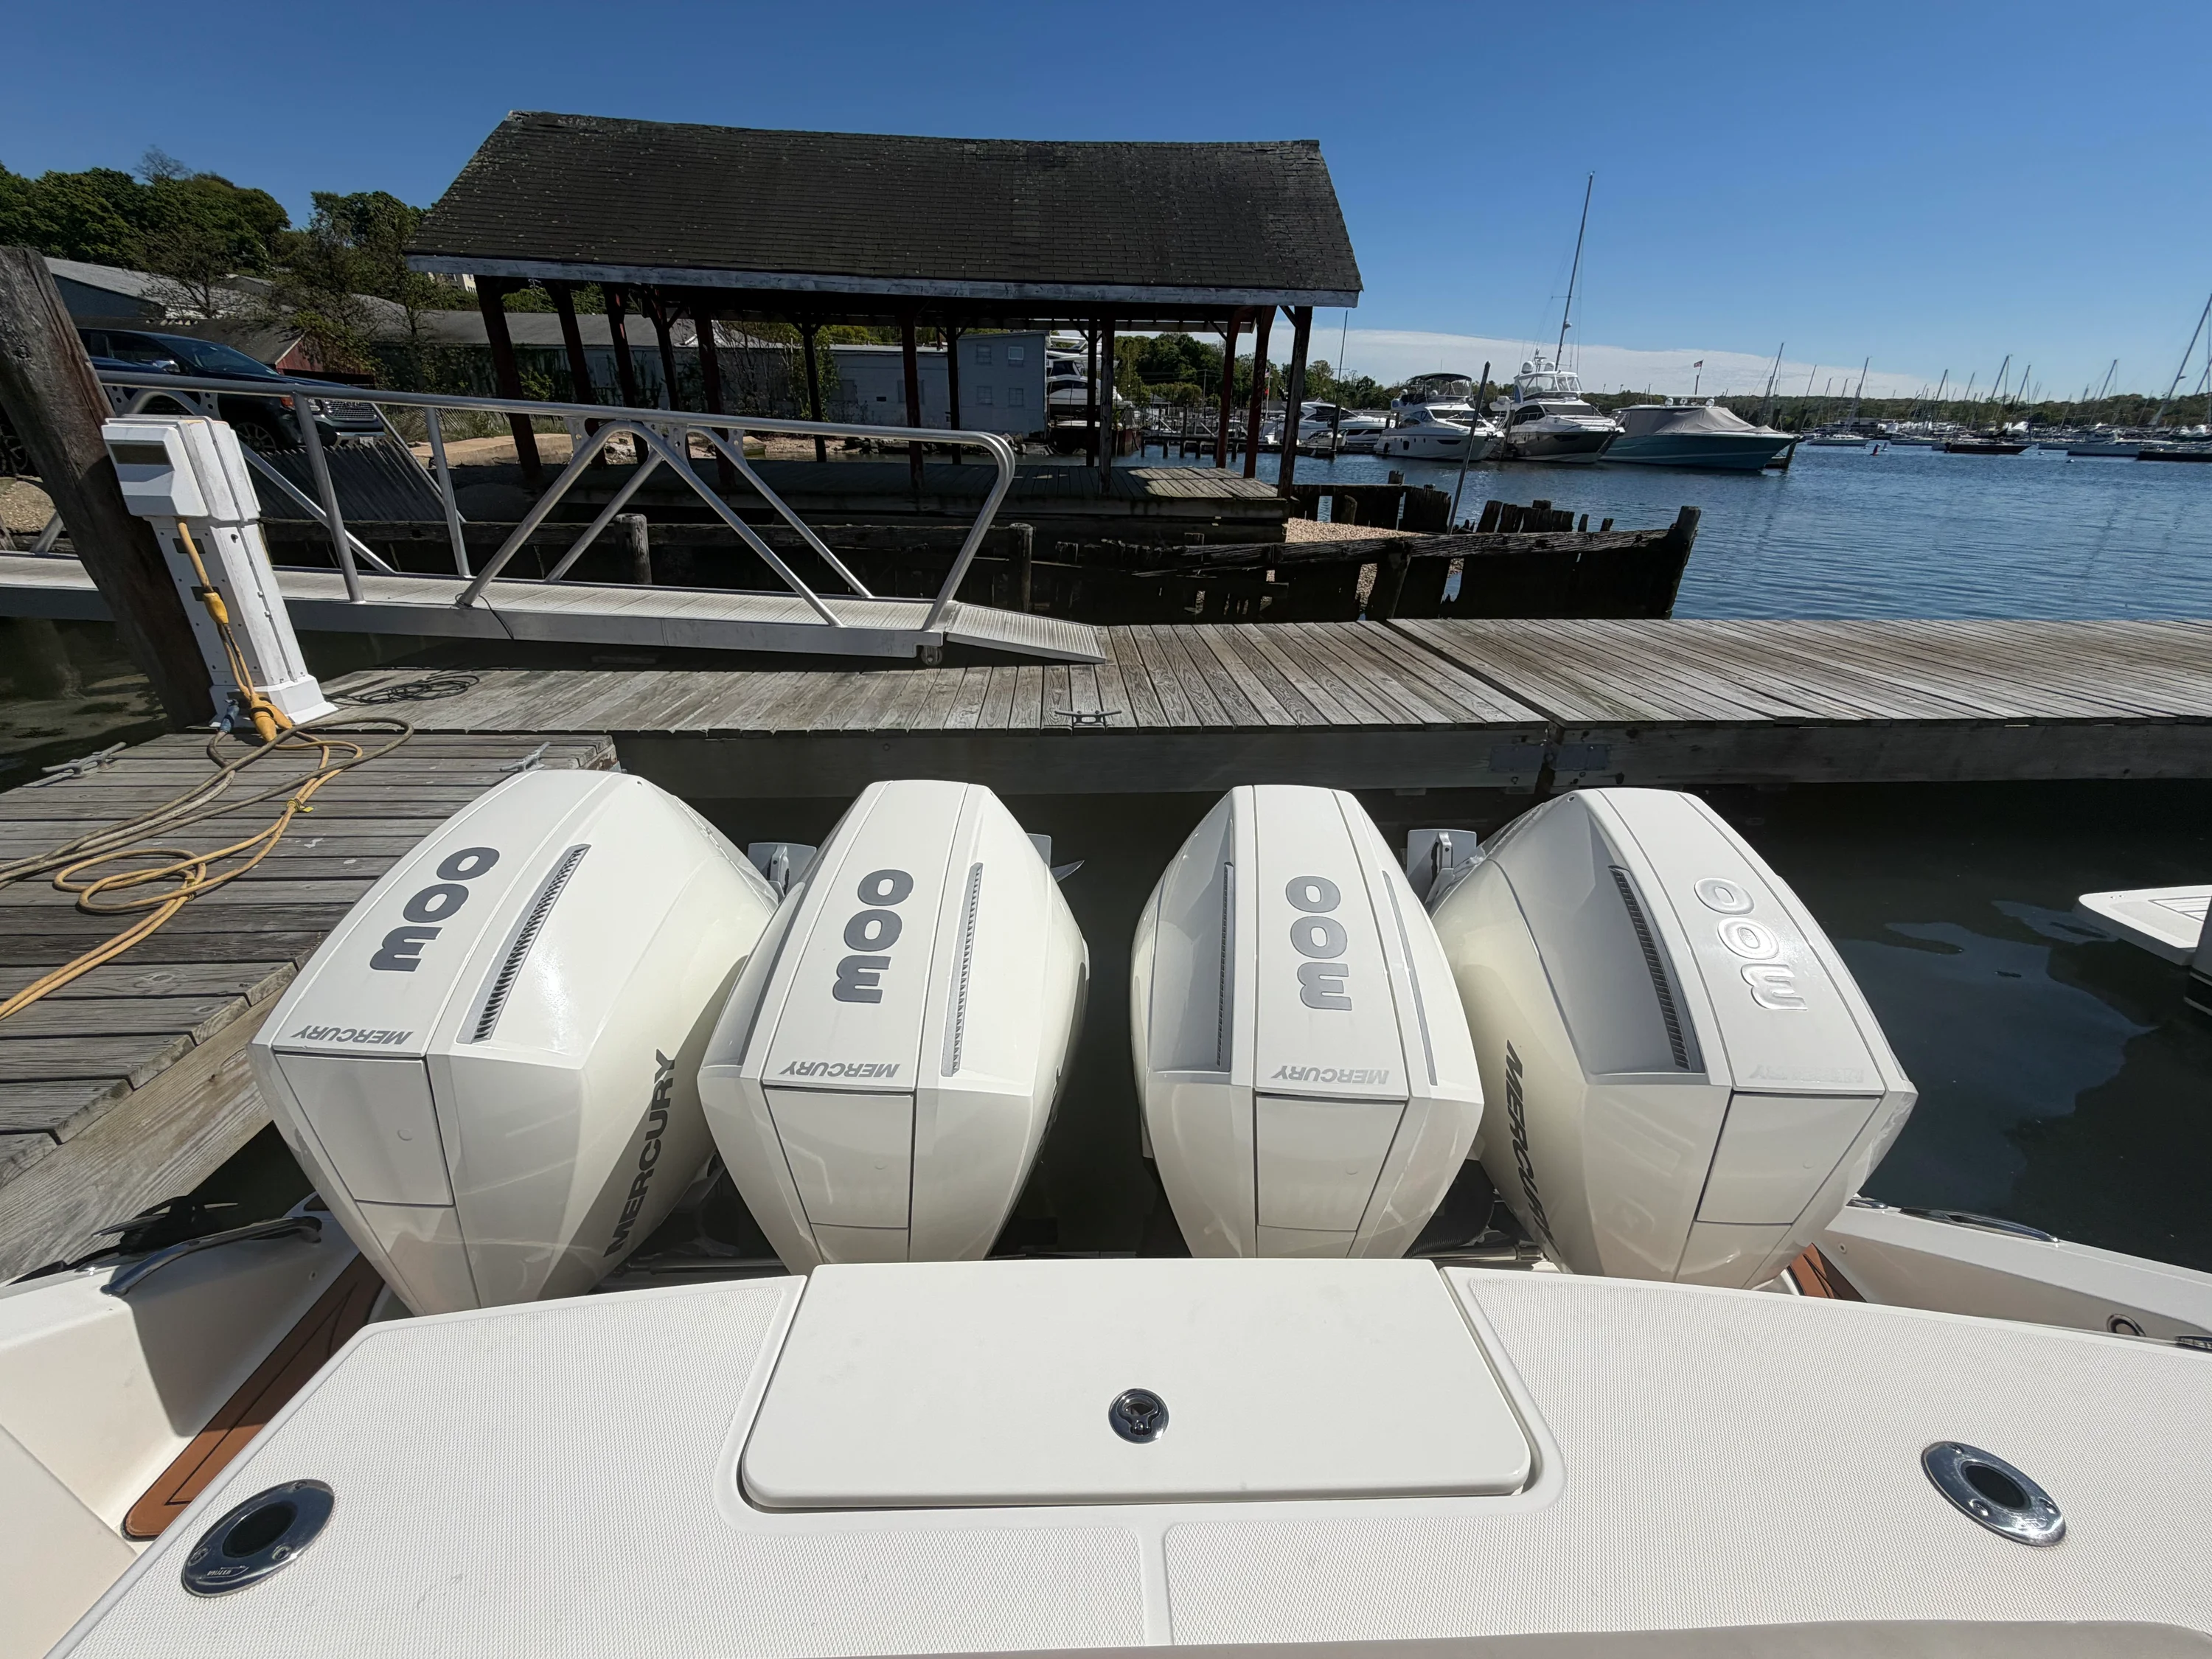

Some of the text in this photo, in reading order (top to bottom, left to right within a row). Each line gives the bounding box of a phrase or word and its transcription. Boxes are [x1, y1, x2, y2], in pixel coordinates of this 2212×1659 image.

[370, 847, 500, 972] 300
[832, 869, 914, 1004] 300
[1284, 875, 1352, 1011] 300
[1694, 877, 1808, 1010] 300
[291, 1025, 414, 1045] MERCURY
[778, 1061, 900, 1078] MERCURY
[1270, 1065, 1390, 1085] MERCURY
[602, 1048, 675, 1258] MERCURY
[1506, 1039, 1561, 1257] MERCURY
